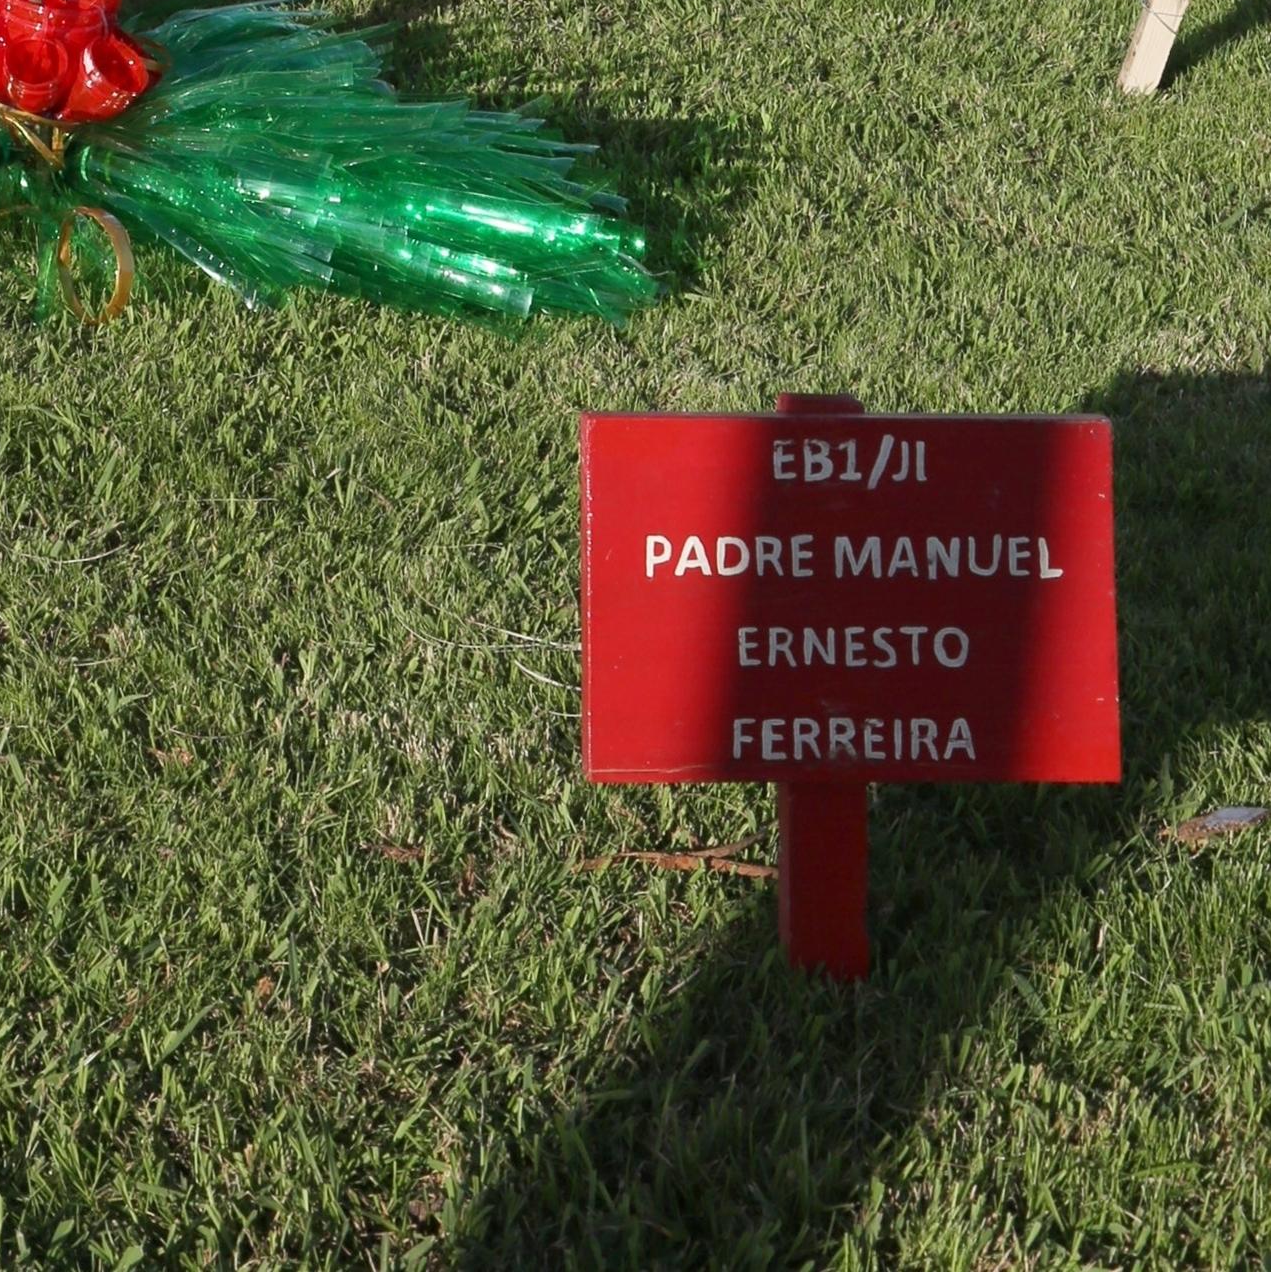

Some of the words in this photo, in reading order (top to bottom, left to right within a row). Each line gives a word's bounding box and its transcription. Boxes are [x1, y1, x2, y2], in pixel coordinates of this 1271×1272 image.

[772, 434, 928, 489] EB1/JI
[644, 534, 814, 579] PADRE
[833, 534, 1065, 580] MANUEL
[737, 626, 970, 668] ERNESTO
[732, 716, 977, 762] FERREIRA
